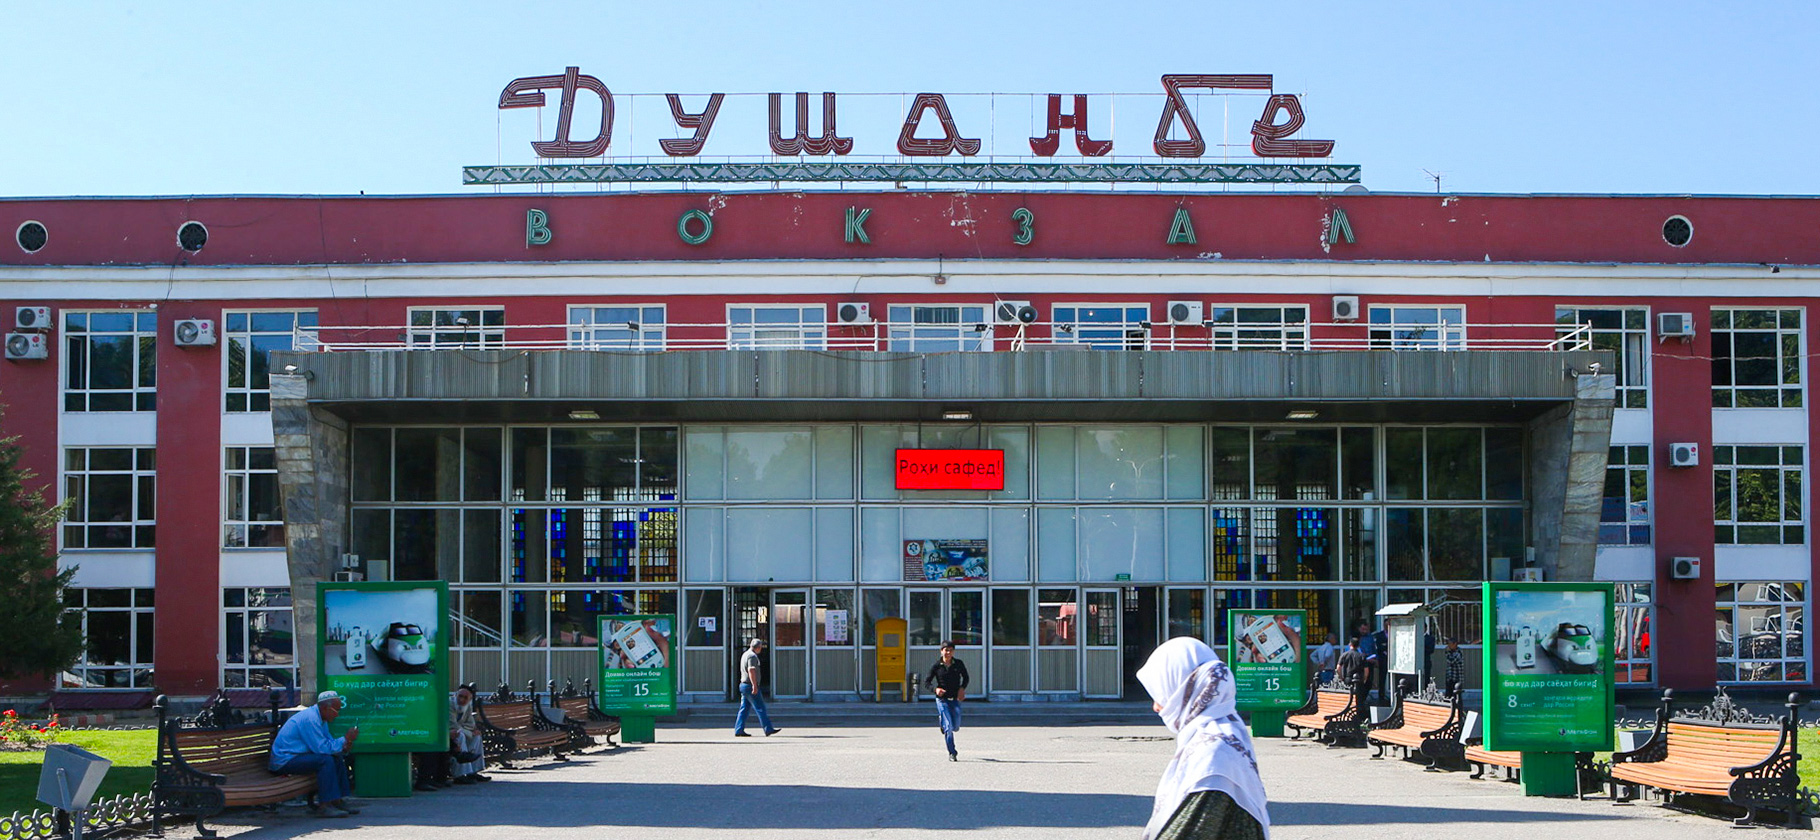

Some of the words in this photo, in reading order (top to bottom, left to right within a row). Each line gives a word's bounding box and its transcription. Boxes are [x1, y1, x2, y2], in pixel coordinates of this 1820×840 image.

[499, 67, 1335, 158] Душанбе
[526, 208, 1357, 247] ВОКЗАЛ
[899, 459, 938, 475] Роҳи
[944, 460, 1000, 477] сафед!
[333, 680, 345, 688] Бо
[345, 681, 360, 689] худ
[360, 680, 376, 689] дар
[376, 679, 403, 688] саёҳат
[404, 679, 428, 689] бигир
[634, 683, 649, 697] 15
[1265, 677, 1280, 691] 15
[1530, 680, 1545, 688] дар
[1546, 679, 1572, 688] саёҳат
[1507, 694, 1518, 708] 8
